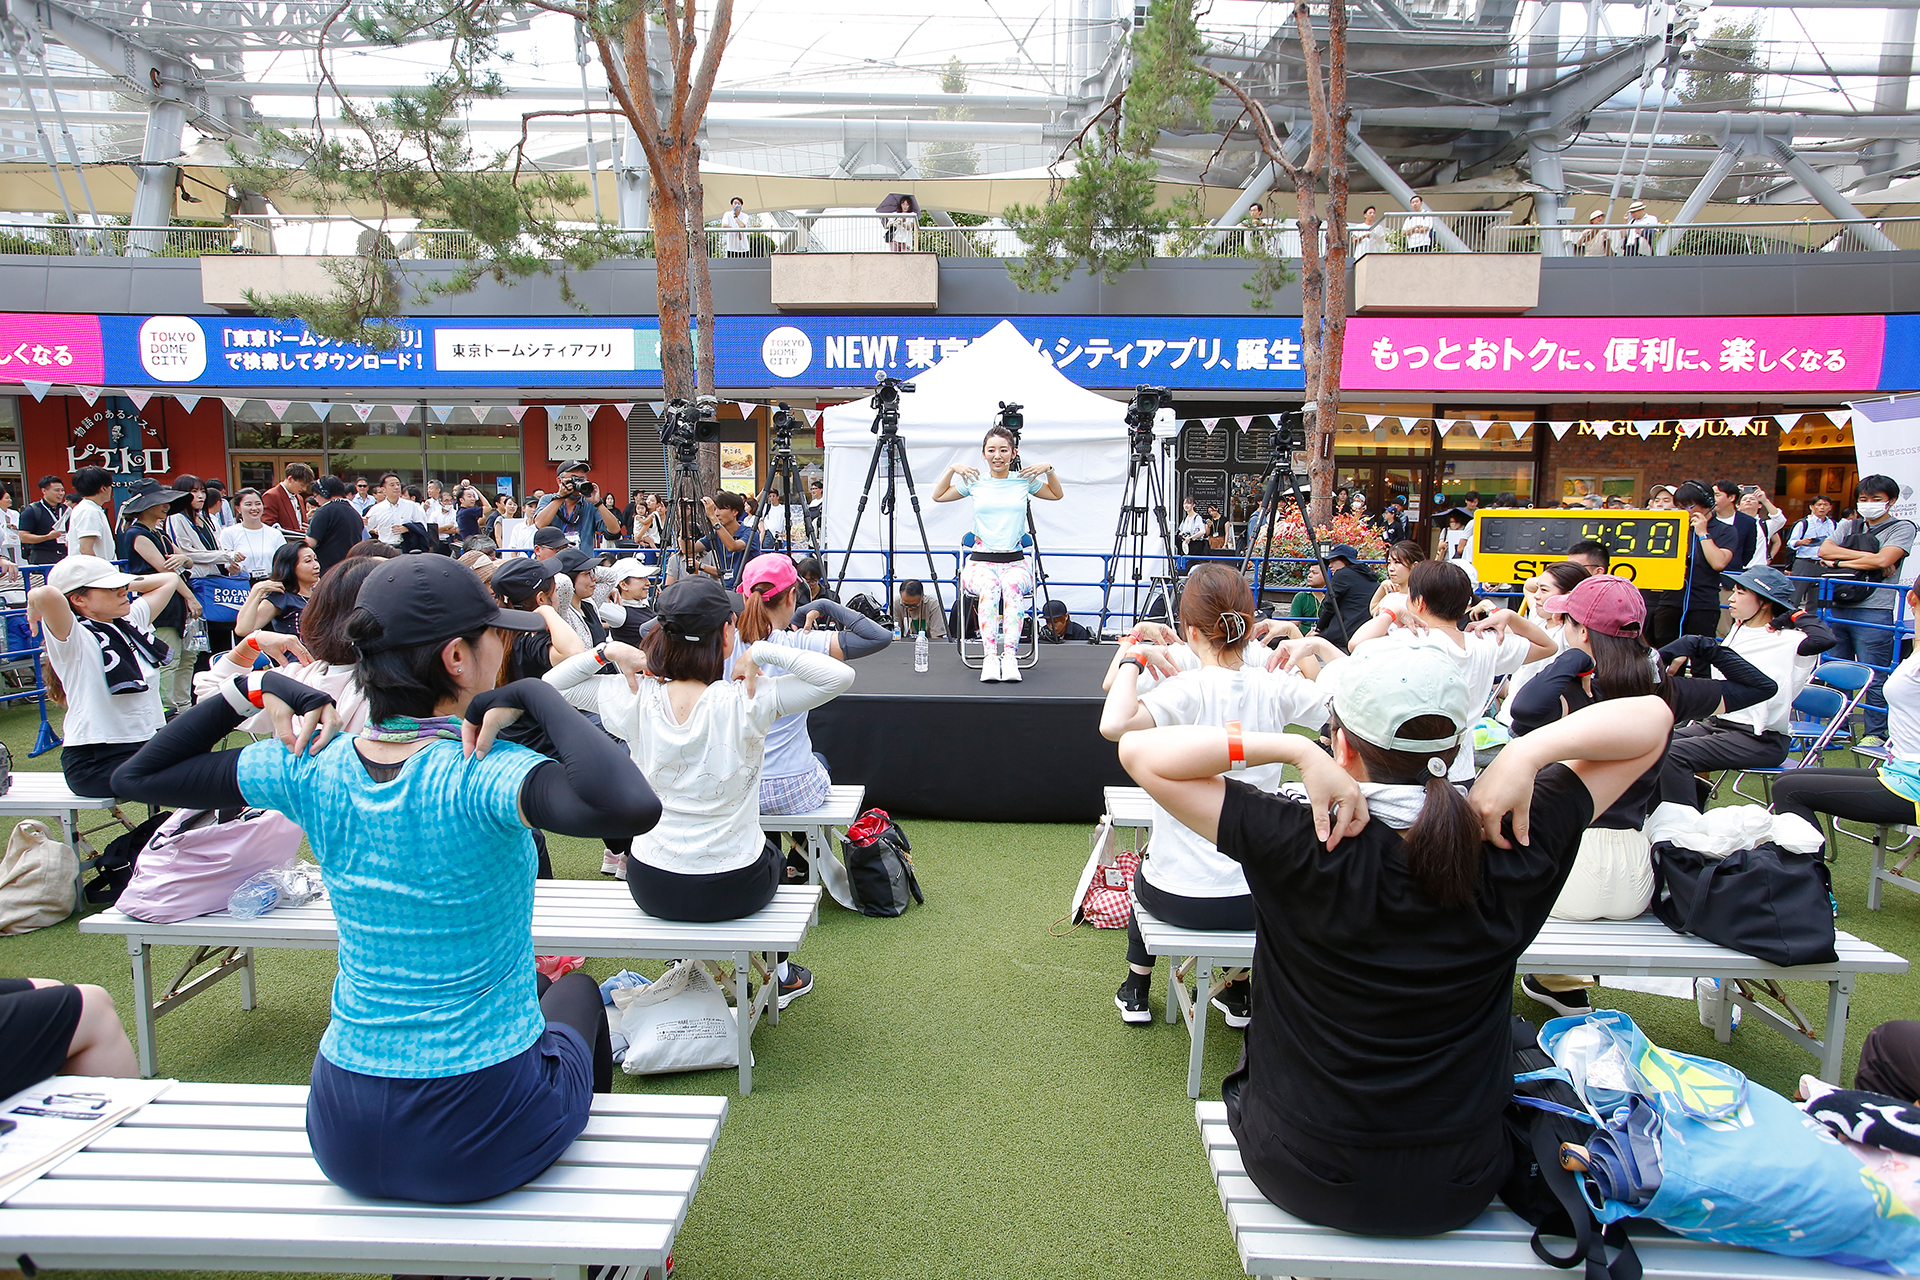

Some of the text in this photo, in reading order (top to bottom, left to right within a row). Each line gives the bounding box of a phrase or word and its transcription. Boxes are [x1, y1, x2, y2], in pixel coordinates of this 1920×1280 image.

[150, 332, 196, 342] TOKYO
[223, 328, 423, 349] 「東京ドームシリ」
[770, 339, 805, 347] TOKYO
[150, 344, 188, 354] DOME
[452, 343, 613, 358] 東京ドームシティアプリ
[769, 348, 798, 356] DOME
[825, 335, 899, 369] NEW!
[151, 355, 188, 366] CITY
[769, 357, 798, 366] CITY
[73, 409, 158, 438] 物語のあるパスタ
[554, 423, 582, 432] 物語の
[1576, 419, 1671, 436] MGUL
[560, 433, 578, 442] ある
[554, 443, 582, 452] パスタ
[66, 443, 171, 474] ピエトロ
